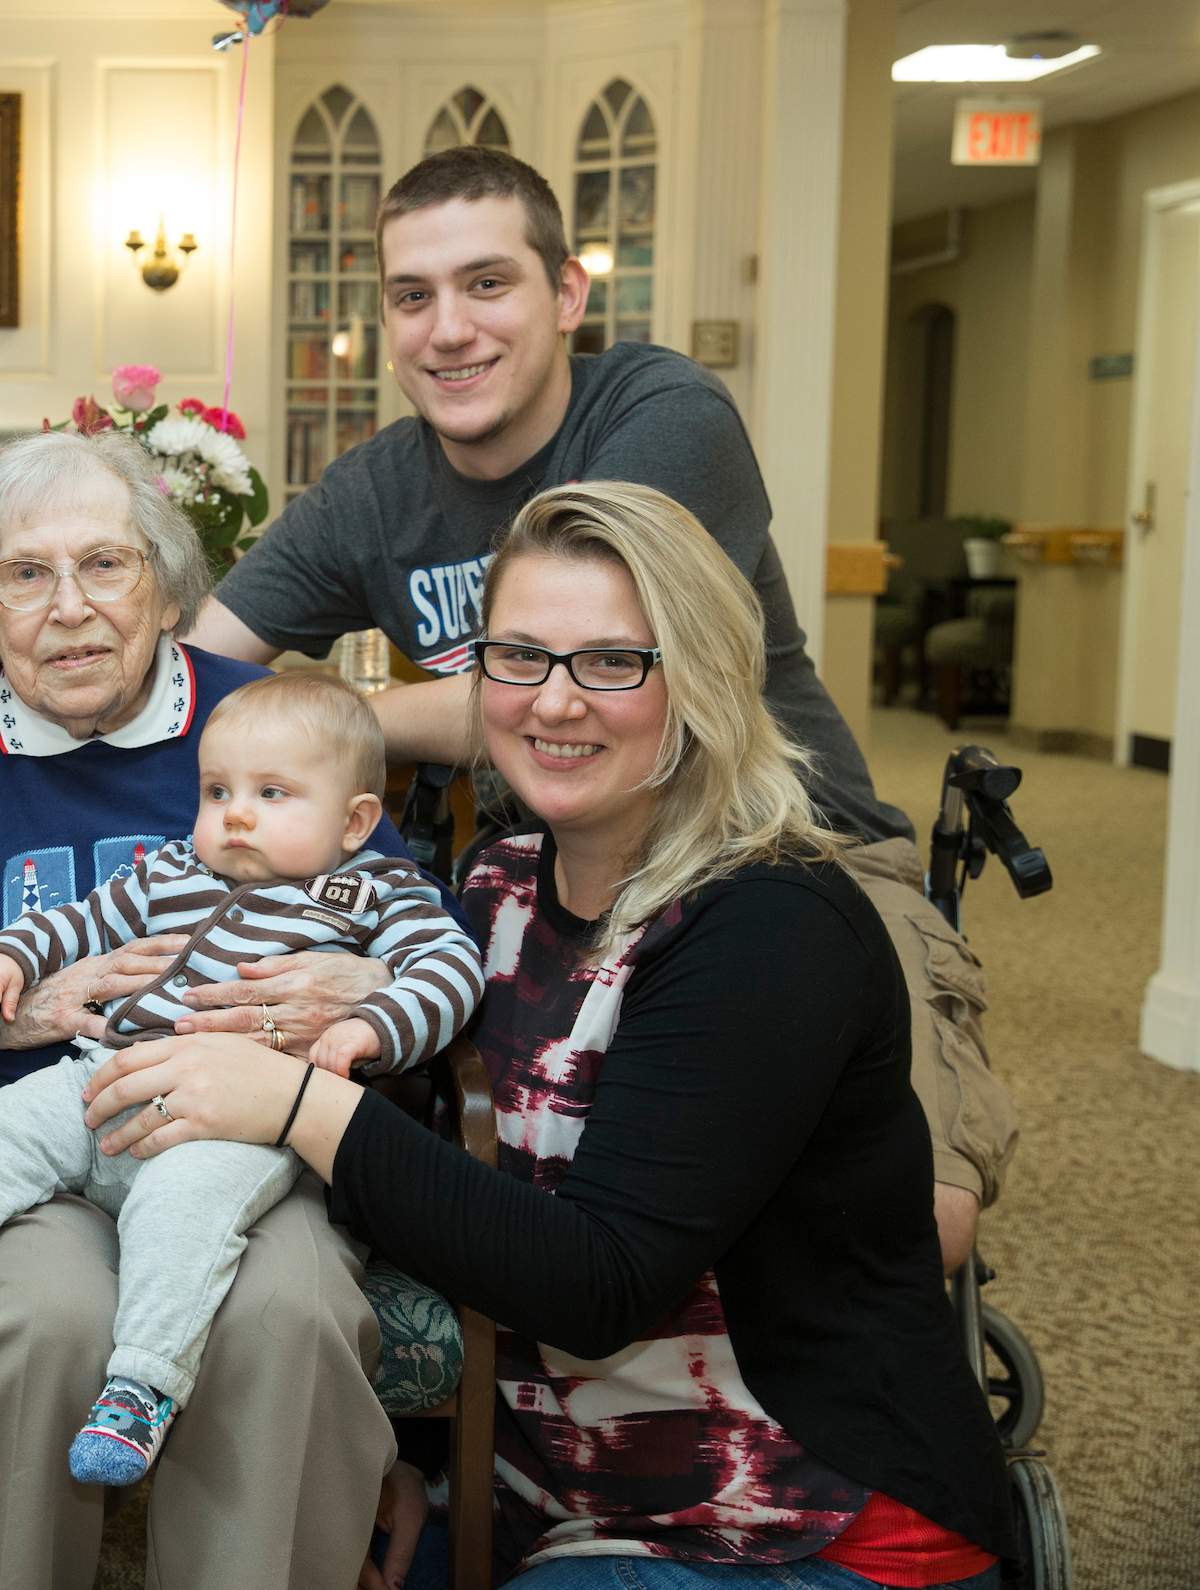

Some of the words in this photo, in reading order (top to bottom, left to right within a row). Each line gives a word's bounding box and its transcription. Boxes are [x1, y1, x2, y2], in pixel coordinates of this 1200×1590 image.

[967, 111, 1031, 161] EXIT
[408, 551, 497, 648] SUPE
[325, 885, 351, 904] 01
